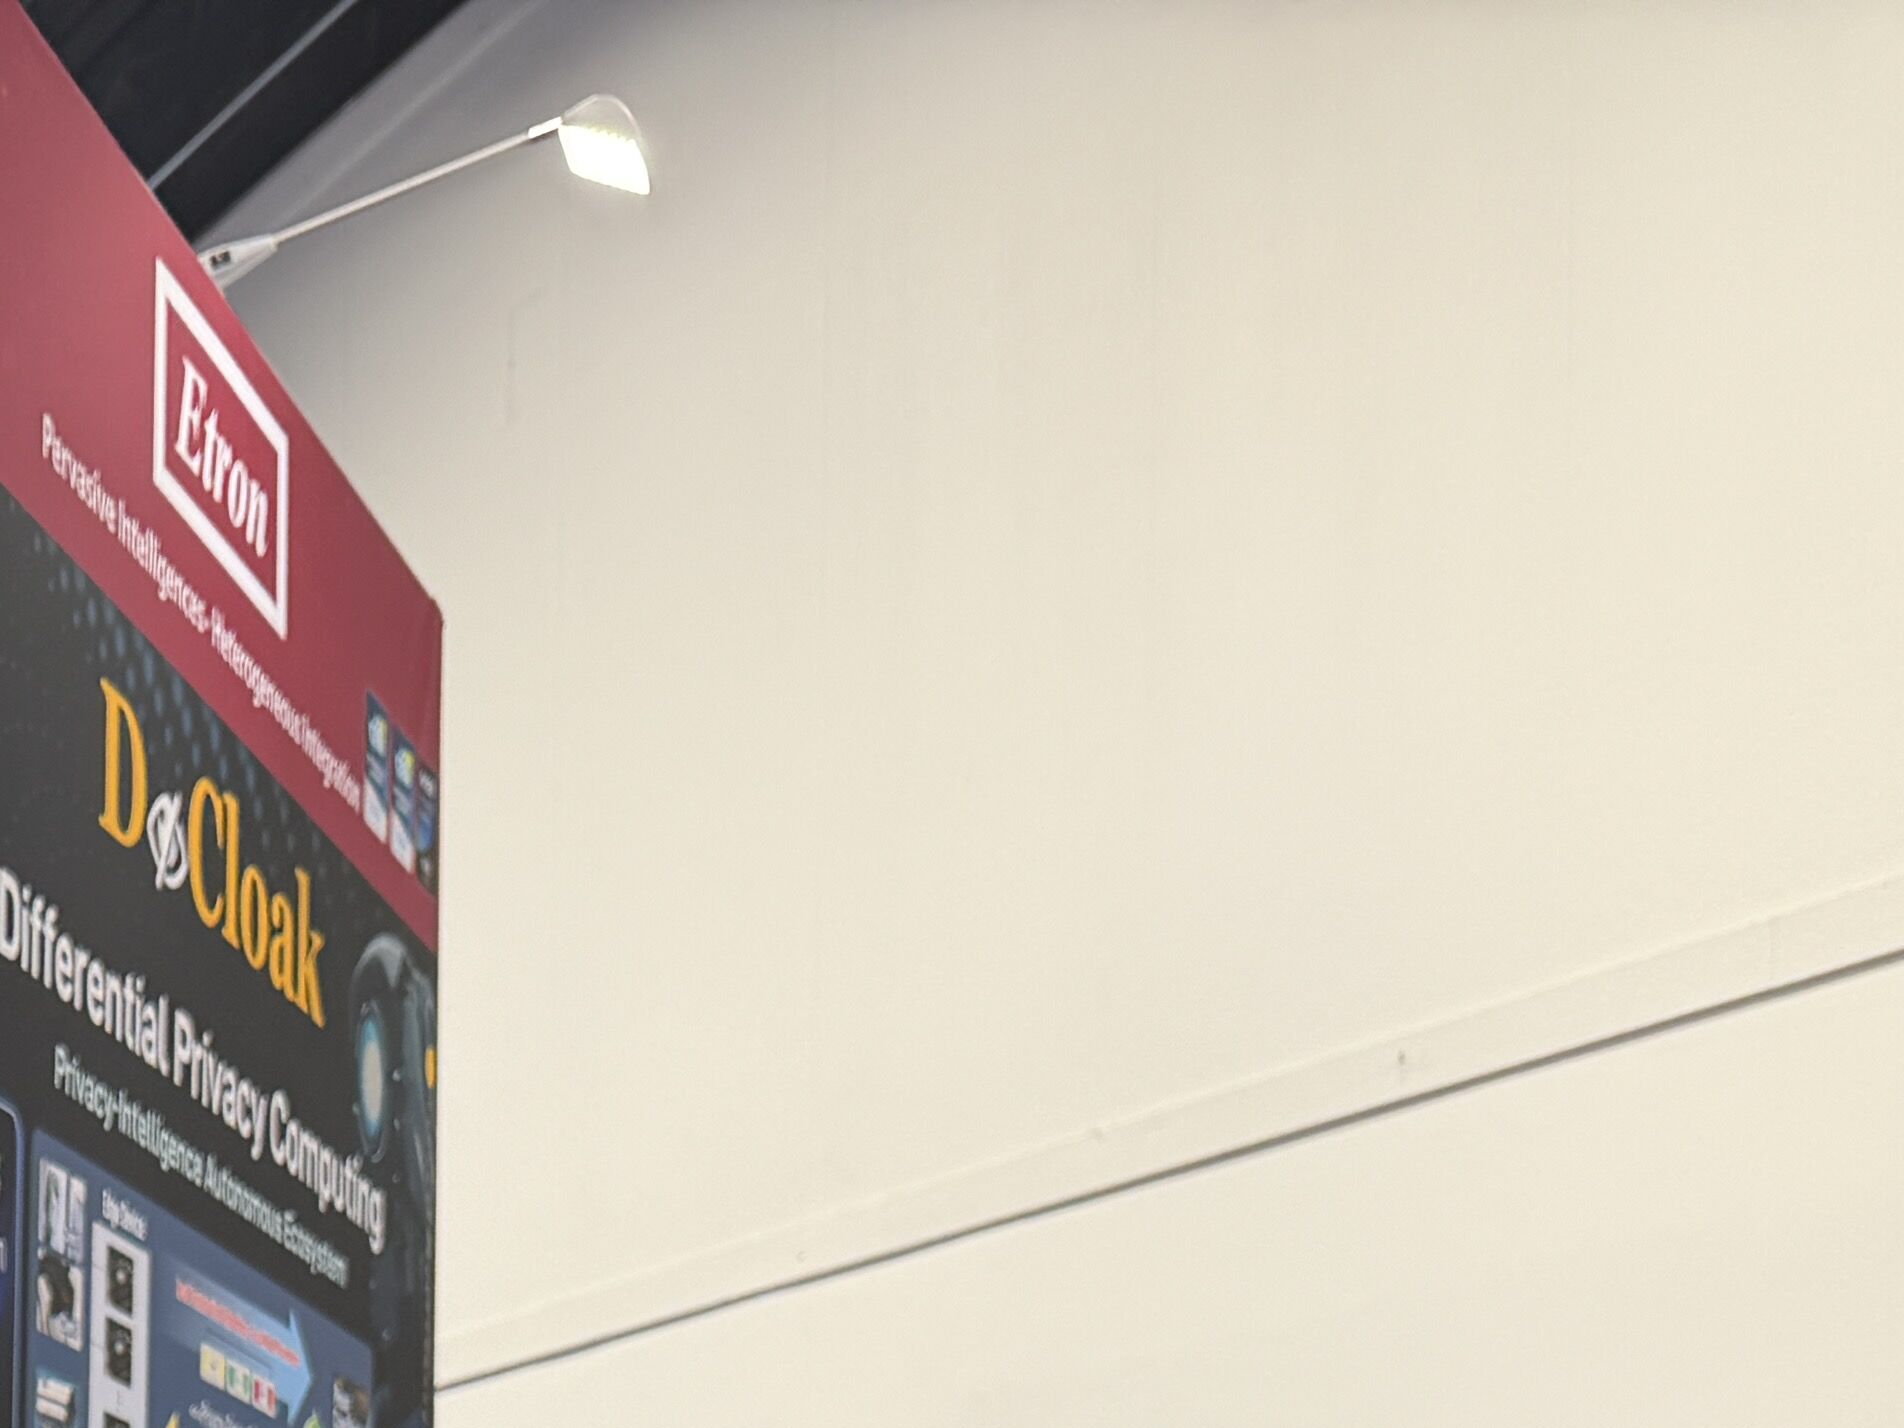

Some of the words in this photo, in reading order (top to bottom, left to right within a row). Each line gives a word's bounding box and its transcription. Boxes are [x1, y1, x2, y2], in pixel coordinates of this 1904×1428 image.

[41, 412, 116, 536] Pervasive
[173, 354, 270, 560] Etron
[172, 1006, 269, 1163] Privacy
[269, 1087, 388, 1257] Computing
